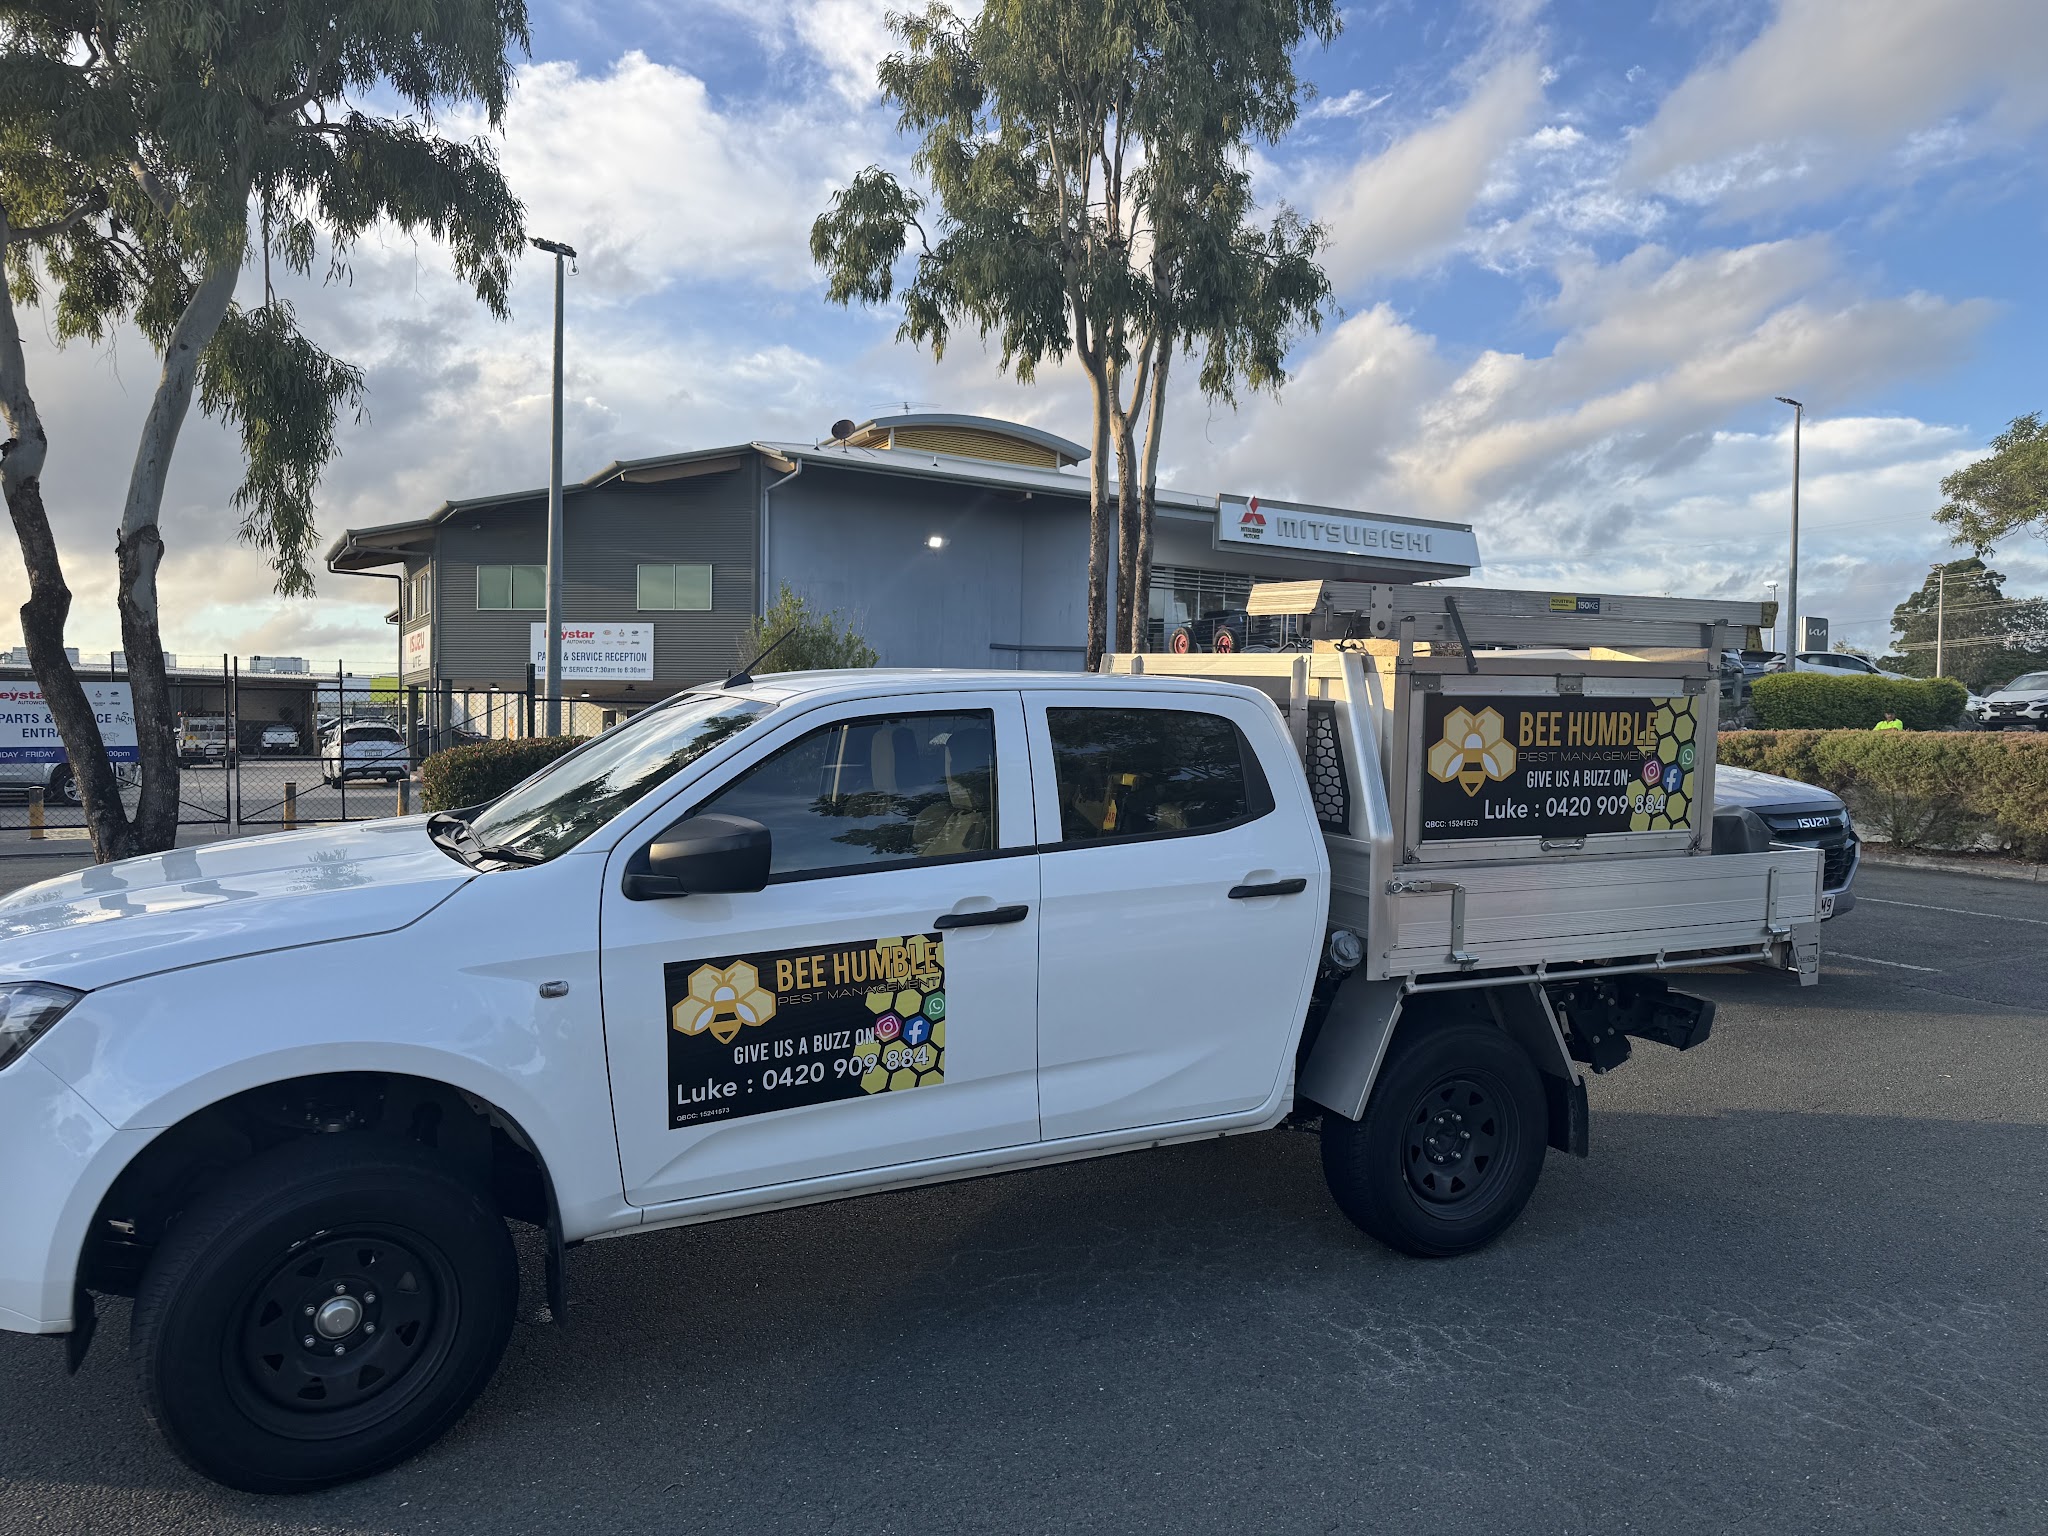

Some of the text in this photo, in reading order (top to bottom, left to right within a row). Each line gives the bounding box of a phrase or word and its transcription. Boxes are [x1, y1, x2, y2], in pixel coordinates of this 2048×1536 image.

[1277, 516, 1362, 552] MITSUBISHI
[410, 631, 425, 653] ISUZU
[412, 654, 422, 668] UTE
[563, 651, 647, 662] & SERVICE RECEPTION
[0, 690, 45, 701] eysta
[44, 713, 54, 724] &
[1519, 711, 1659, 747] BEE HUMBLE
[106, 750, 131, 759] :00pm
[1518, 750, 1656, 763] PEST MANAGEMENT
[1526, 770, 1553, 788] GIVE
[1555, 769, 1570, 788] US
[1572, 770, 1580, 787] A
[1583, 769, 1611, 787] BUZZ
[1484, 798, 1528, 820] Luke
[1546, 796, 1591, 818] 0420
[1596, 795, 1628, 816] 909
[1634, 794, 1666, 814] 884
[1424, 819, 1479, 829] QBCC: 15241573
[1797, 817, 1830, 829] ISUZU
[776, 942, 940, 992] BEE HUMBLE
[777, 976, 940, 1006] PEST MANAGEMENT
[733, 1042, 770, 1065] GIVE
[774, 1039, 794, 1059] US
[798, 1036, 809, 1056] A
[813, 1030, 851, 1053] BUZZ
[677, 1077, 738, 1105] Luke
[762, 1061, 825, 1091] 0420
[833, 1053, 878, 1079] 909
[886, 1045, 930, 1070] 884
[676, 1107, 730, 1122] QBCC: 15241573
